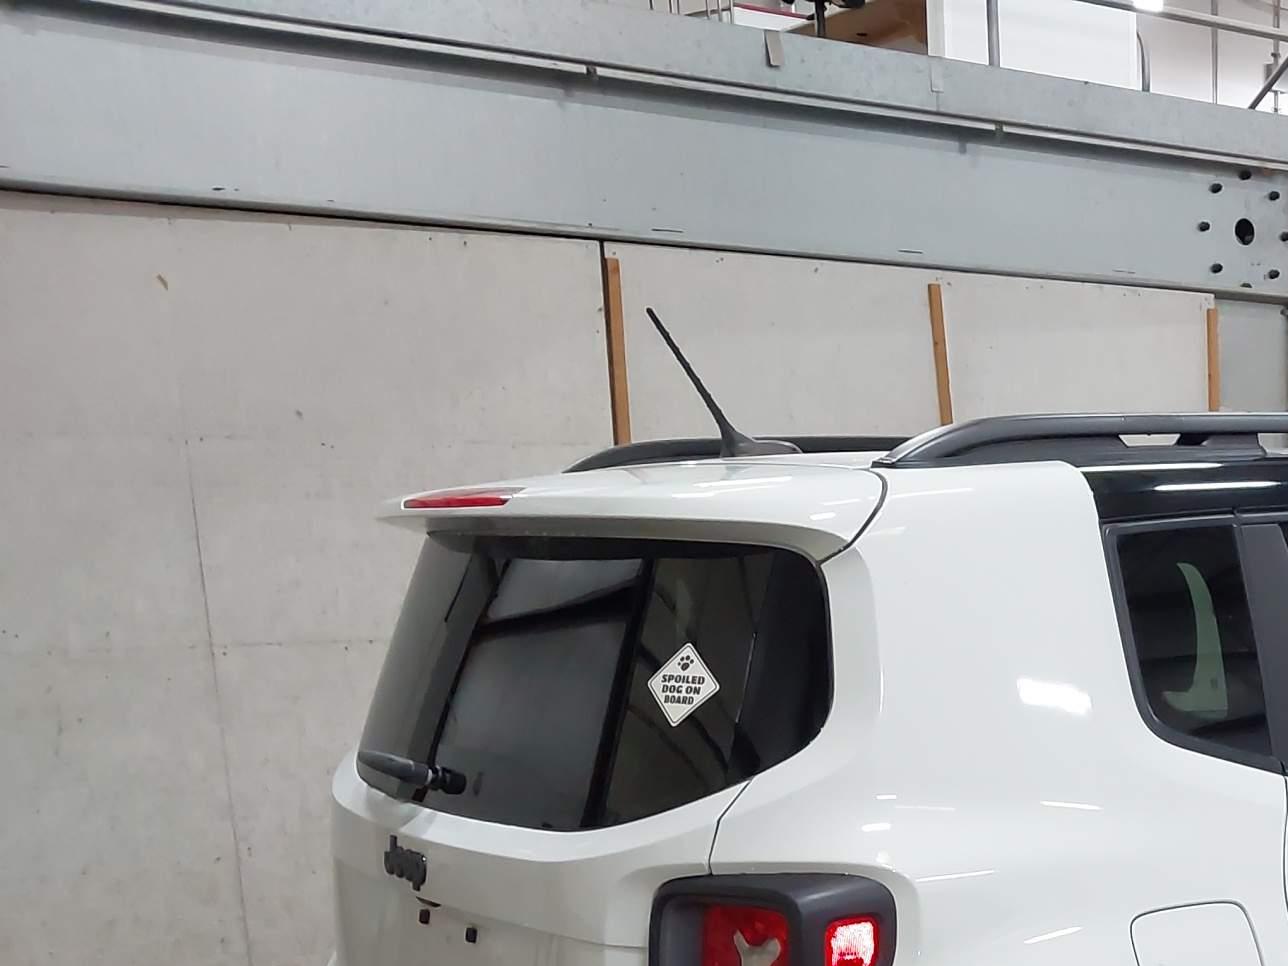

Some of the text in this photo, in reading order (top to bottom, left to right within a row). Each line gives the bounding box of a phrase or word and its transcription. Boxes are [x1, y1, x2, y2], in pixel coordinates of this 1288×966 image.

[661, 674, 705, 685] SPOILED
[661, 684, 701, 695] DOG ON
[663, 694, 695, 705] BOARD
